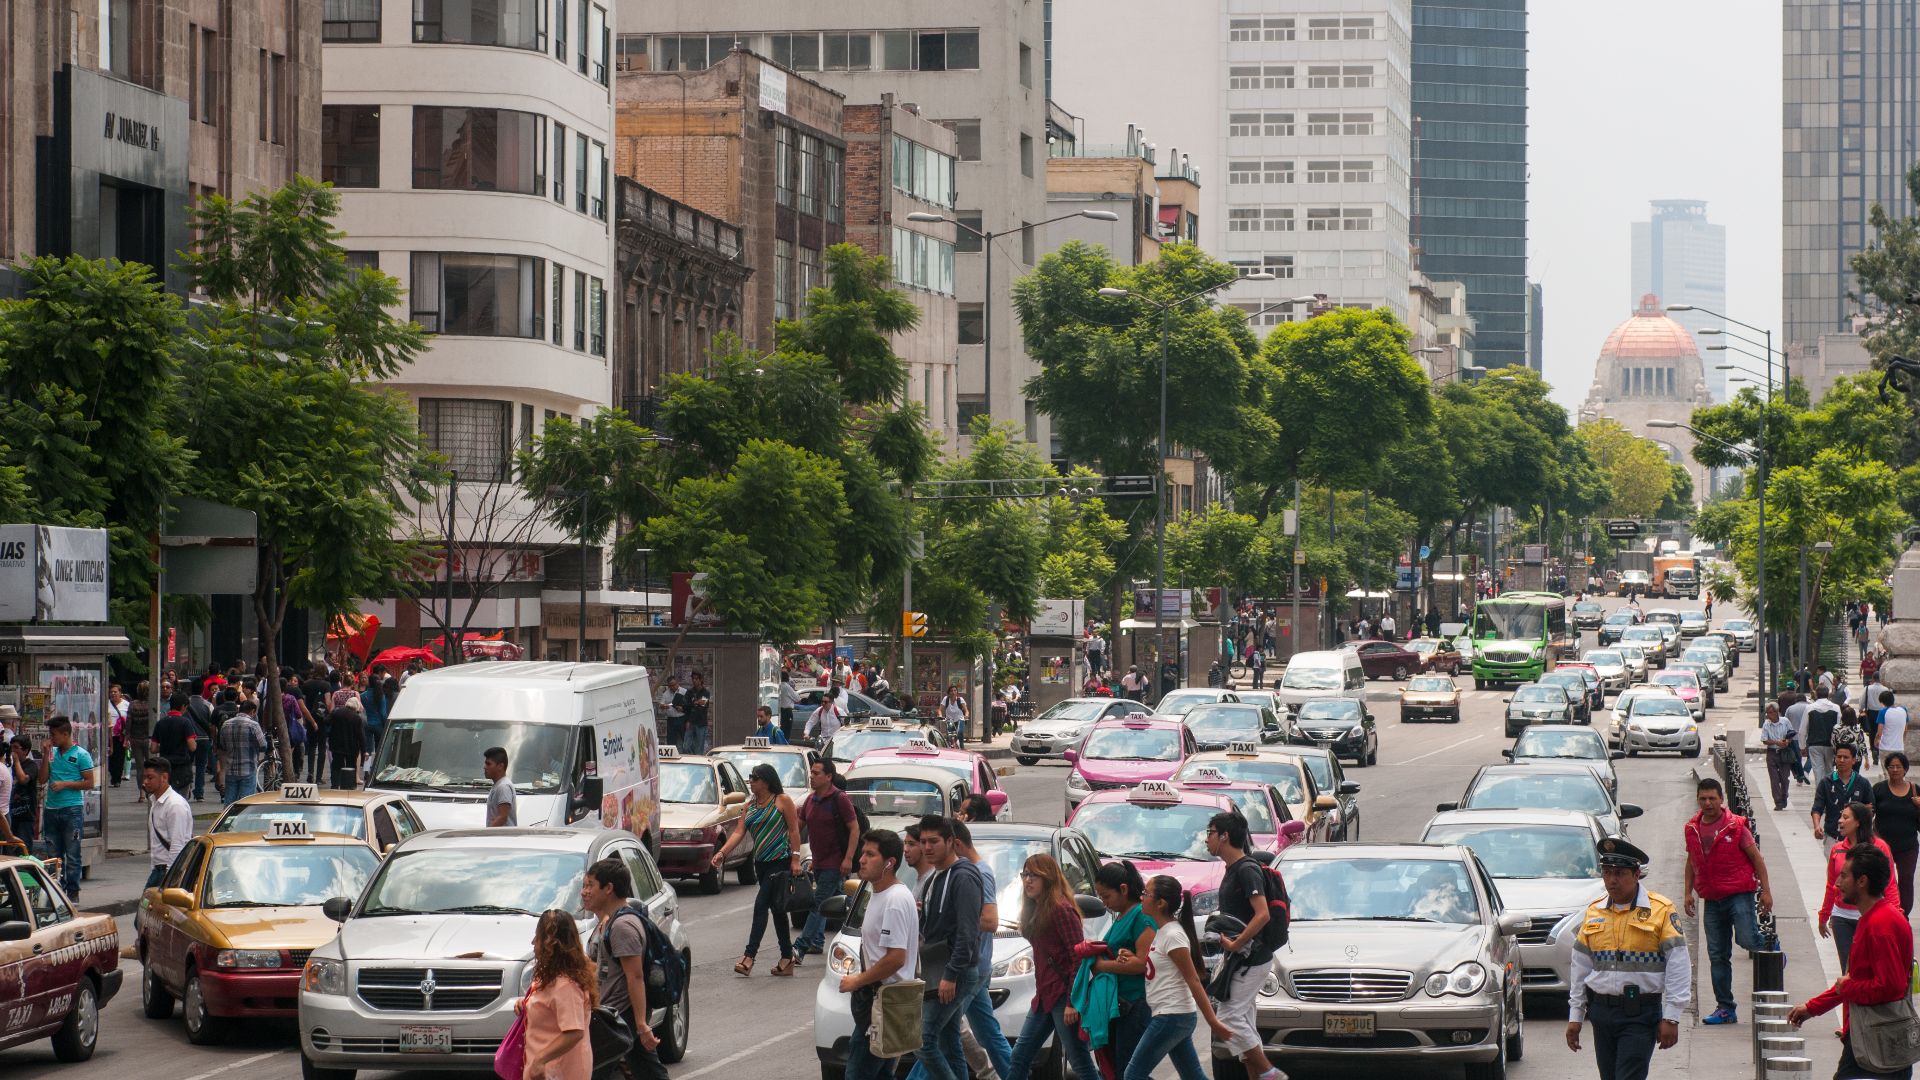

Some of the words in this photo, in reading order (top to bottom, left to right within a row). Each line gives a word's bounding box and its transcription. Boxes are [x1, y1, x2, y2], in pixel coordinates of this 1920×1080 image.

[55, 558, 73, 582] ONCE
[75, 559, 105, 583] NOTICIAS
[872, 718, 889, 726] TAXI
[748, 738, 767, 747] TAXI
[1232, 743, 1254, 752] TAXI
[658, 748, 673, 757] AXI
[1142, 783, 1166, 792] TAXI
[284, 787, 313, 799] TAXI
[274, 823, 306, 836] TAXI
[6, 1003, 34, 1028] TAXI
